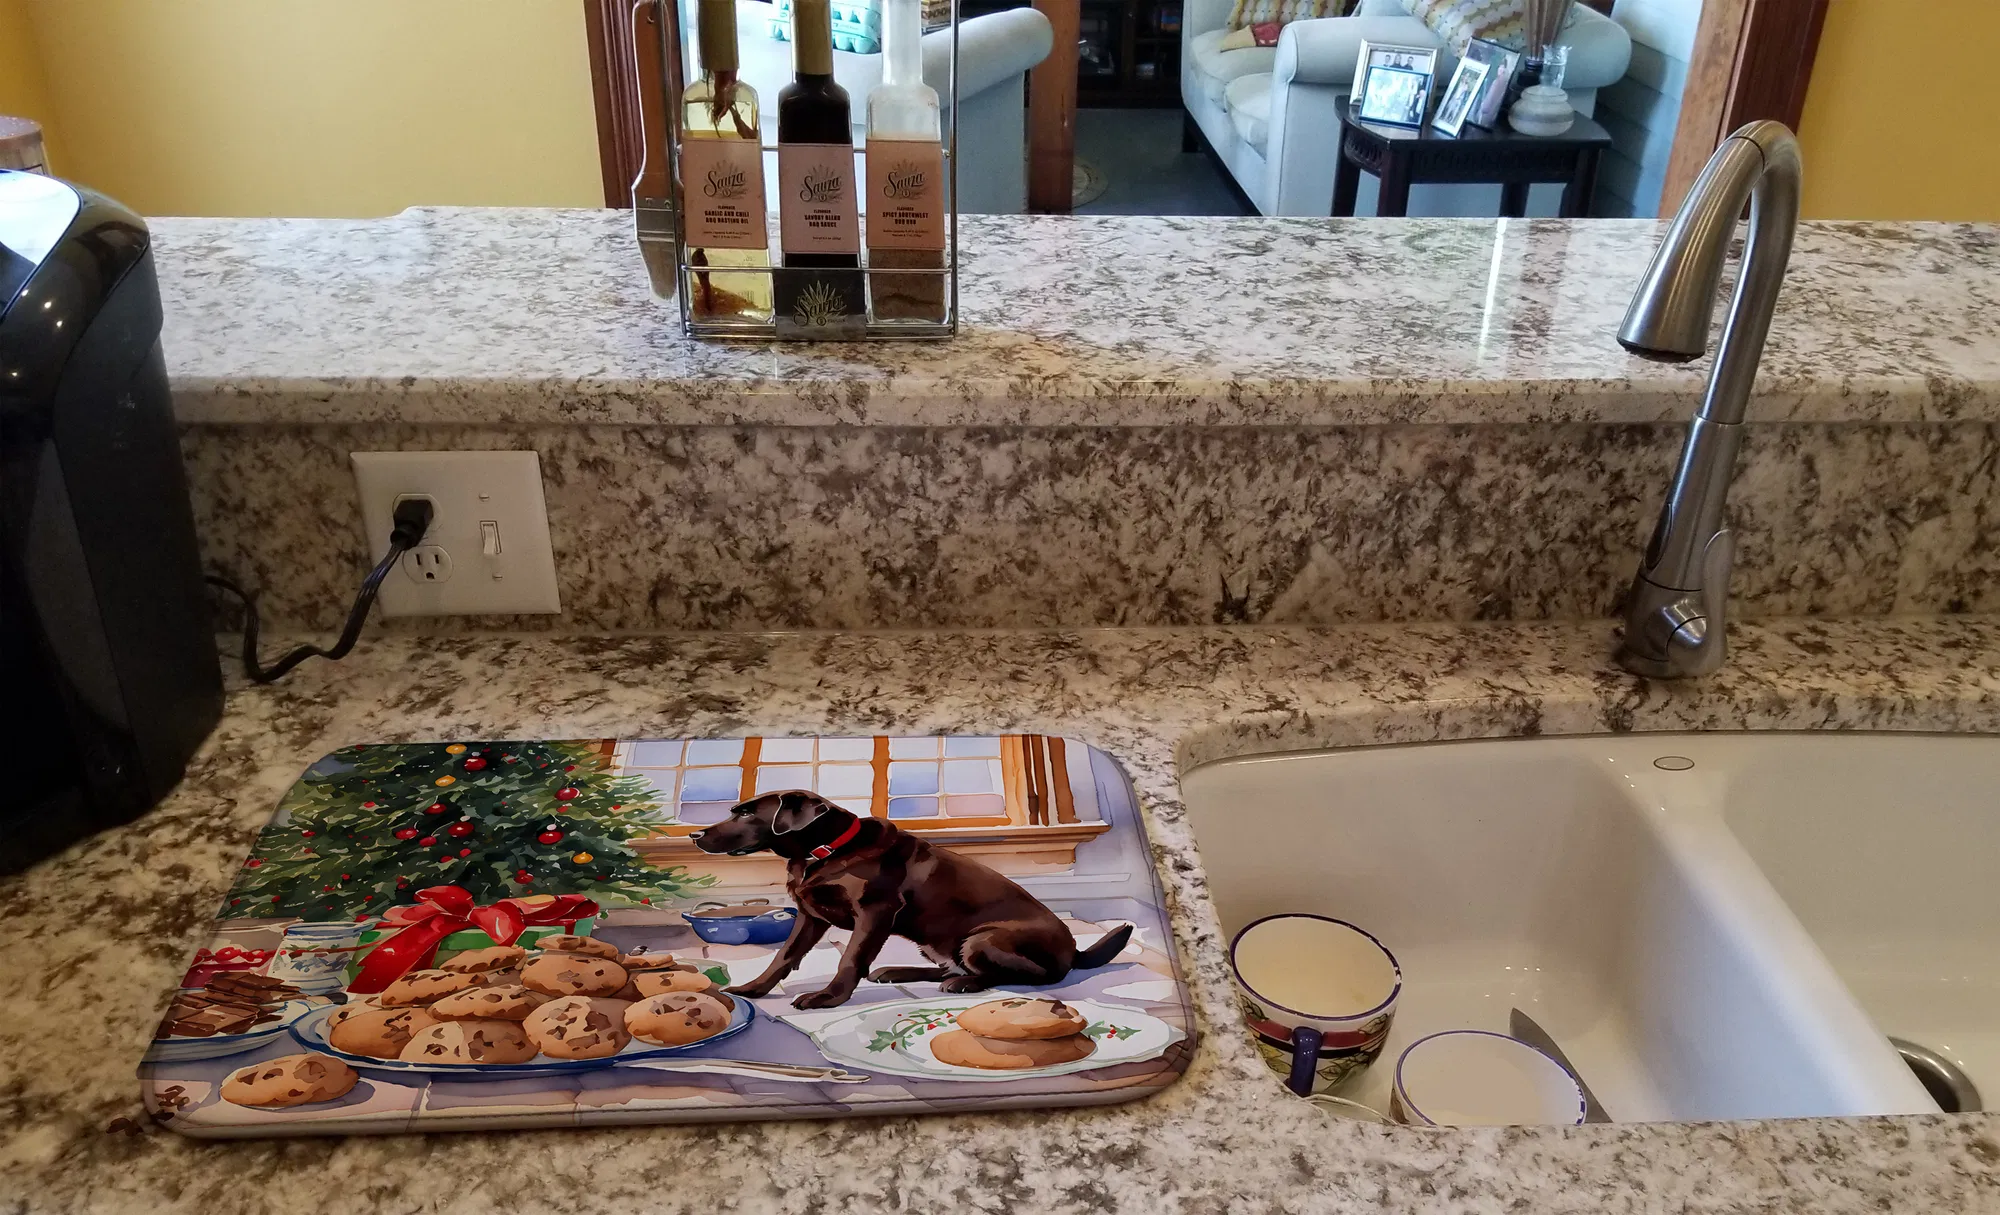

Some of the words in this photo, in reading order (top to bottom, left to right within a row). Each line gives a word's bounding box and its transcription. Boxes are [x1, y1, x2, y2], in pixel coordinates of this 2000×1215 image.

[703, 170, 745, 197] Sauza
[800, 175, 841, 202] Sauza
[883, 171, 925, 198] Sauza
[793, 295, 843, 326] Sauza
